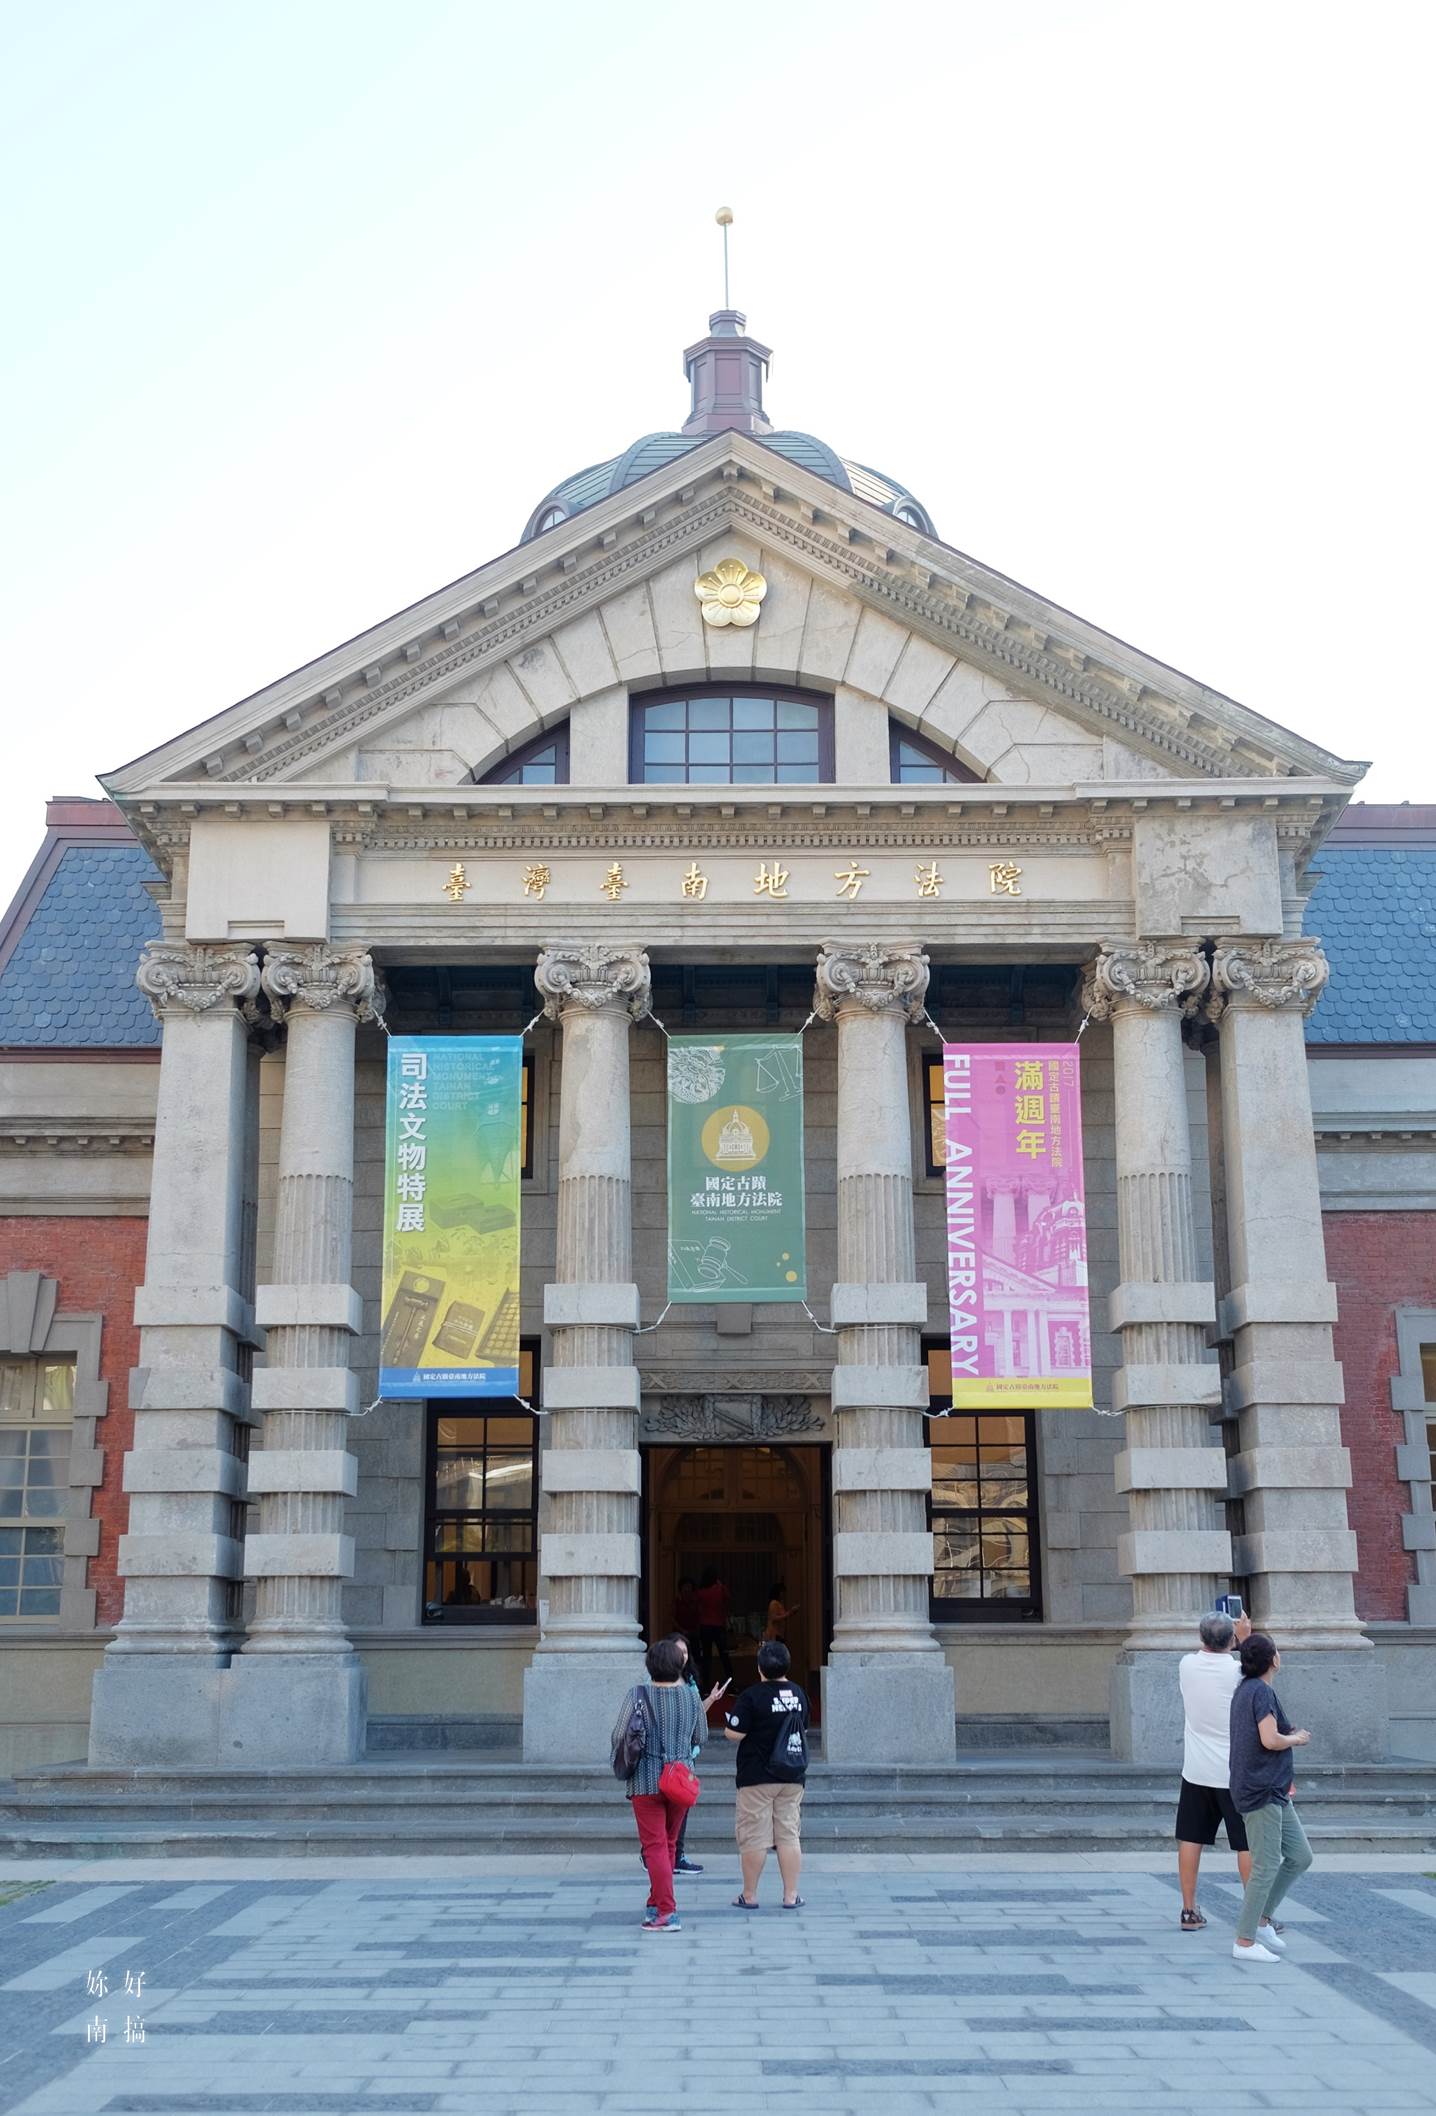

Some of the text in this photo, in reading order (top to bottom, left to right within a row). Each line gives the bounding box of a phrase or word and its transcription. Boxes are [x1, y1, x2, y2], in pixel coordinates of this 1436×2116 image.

[441, 861, 1023, 901] 臺灣臺南地方法院
[432, 1053, 484, 1061] NATIONAL
[1062, 1060, 1074, 1088] 2017
[432, 1101, 467, 1110] COURT
[1014, 1060, 1047, 1160] 滿週年
[395, 1053, 428, 1233] 司法文物特展
[705, 1176, 767, 1191] 國定古蹟
[690, 1191, 783, 1207] 臺南地方法院
[944, 1053, 979, 1376] FULL ANNIVERSARY
